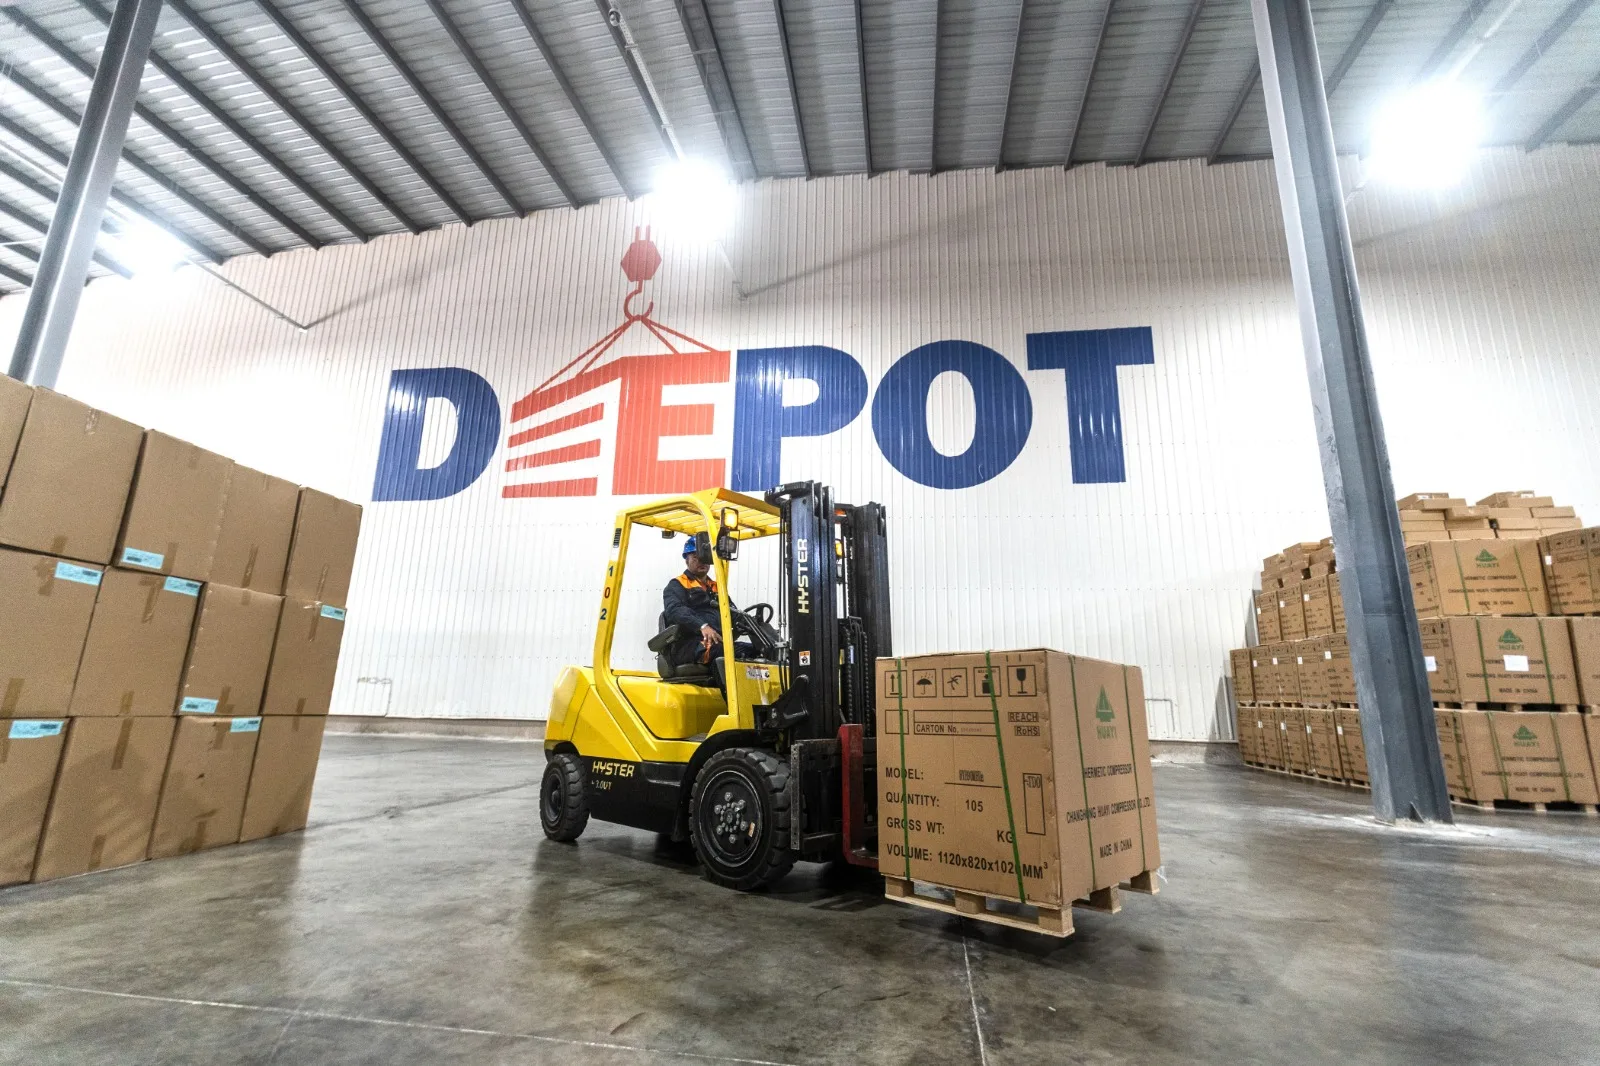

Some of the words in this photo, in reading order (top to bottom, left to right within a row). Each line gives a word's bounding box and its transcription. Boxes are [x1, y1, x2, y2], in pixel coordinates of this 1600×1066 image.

[371, 327, 1154, 502] DEPOT
[797, 538, 809, 614] HYSTER
[1009, 712, 1038, 722] REACH
[916, 724, 945, 733] CARTON
[947, 724, 959, 733] No.
[1016, 726, 1039, 736] RoHS
[1096, 725, 1117, 739] HUAYI
[591, 760, 635, 777] HYSTER
[1107, 764, 1132, 776] COMPRESSOR
[885, 791, 940, 808] QUANTITY:
[965, 799, 984, 812] 105
[1066, 806, 1096, 824] CHANGHNG
[1111, 799, 1136, 814] COMPRESSOR
[886, 817, 922, 832] GROSS
[926, 820, 945, 835] WT:
[996, 830, 1014, 844] KG
[886, 843, 933, 862] VOLUME:
[1100, 843, 1112, 858] MADE
[1113, 841, 1119, 854] IN
[1119, 838, 1133, 852] CHINA
